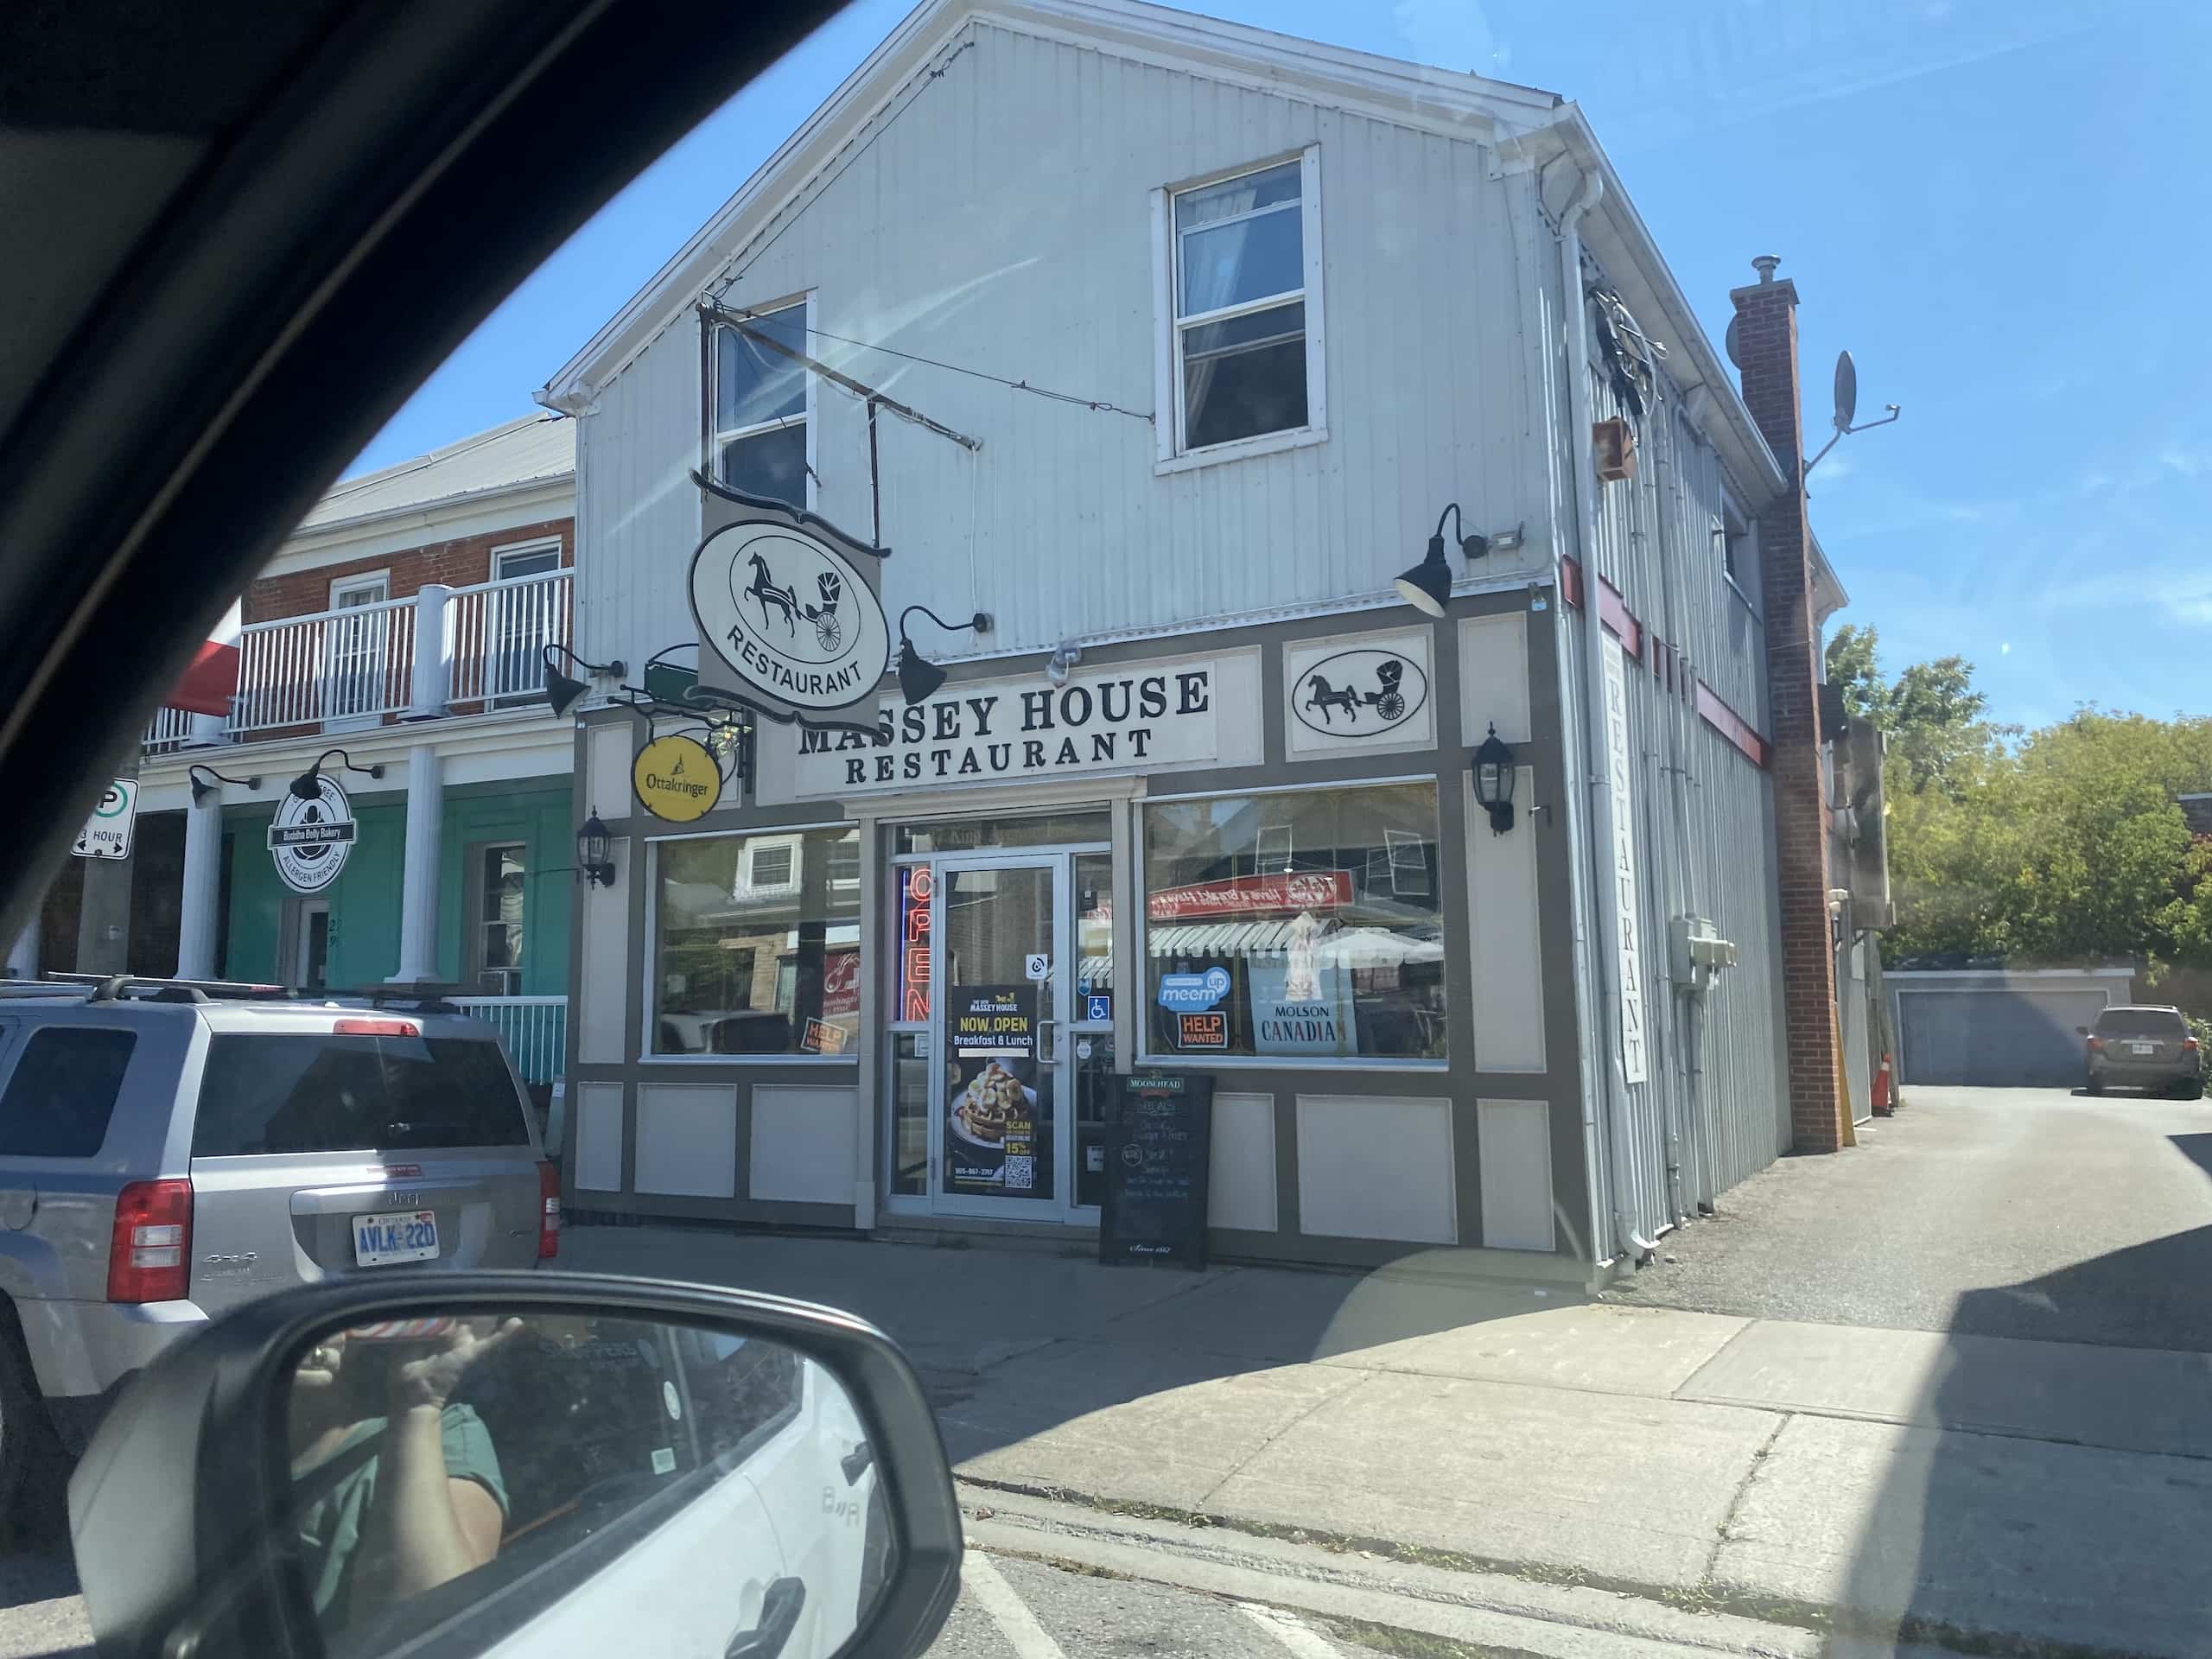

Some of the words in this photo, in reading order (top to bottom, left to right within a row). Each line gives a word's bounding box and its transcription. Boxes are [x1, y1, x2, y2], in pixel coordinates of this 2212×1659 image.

[727, 625, 862, 696] RESTAURANT
[1020, 671, 1209, 732] HOUSE
[844, 728, 1152, 785] RESTAURANT
[646, 773, 709, 798] Ottakringer
[93, 830, 123, 842] HOUR
[321, 827, 341, 840] Bakery
[283, 855, 312, 882] ALLERGEN
[313, 850, 341, 880] FRIENDLY
[1609, 677, 1641, 1073] RESTAURANT
[906, 868, 931, 1023] OPEN
[1210, 977, 1225, 988] up
[1162, 988, 1217, 1001] meem
[1275, 1006, 1329, 1017] MOLSON
[810, 1023, 842, 1039] HELP
[960, 1017, 989, 1032] NOW
[994, 1017, 1027, 1032] OPEN
[1183, 1016, 1221, 1032] HELP
[954, 1035, 996, 1046] Breakfast
[998, 1036, 1004, 1046] &
[1007, 1035, 1033, 1046] Lunch
[1184, 1033, 1224, 1044] WANTED
[1006, 1121, 1031, 1129] SCAN
